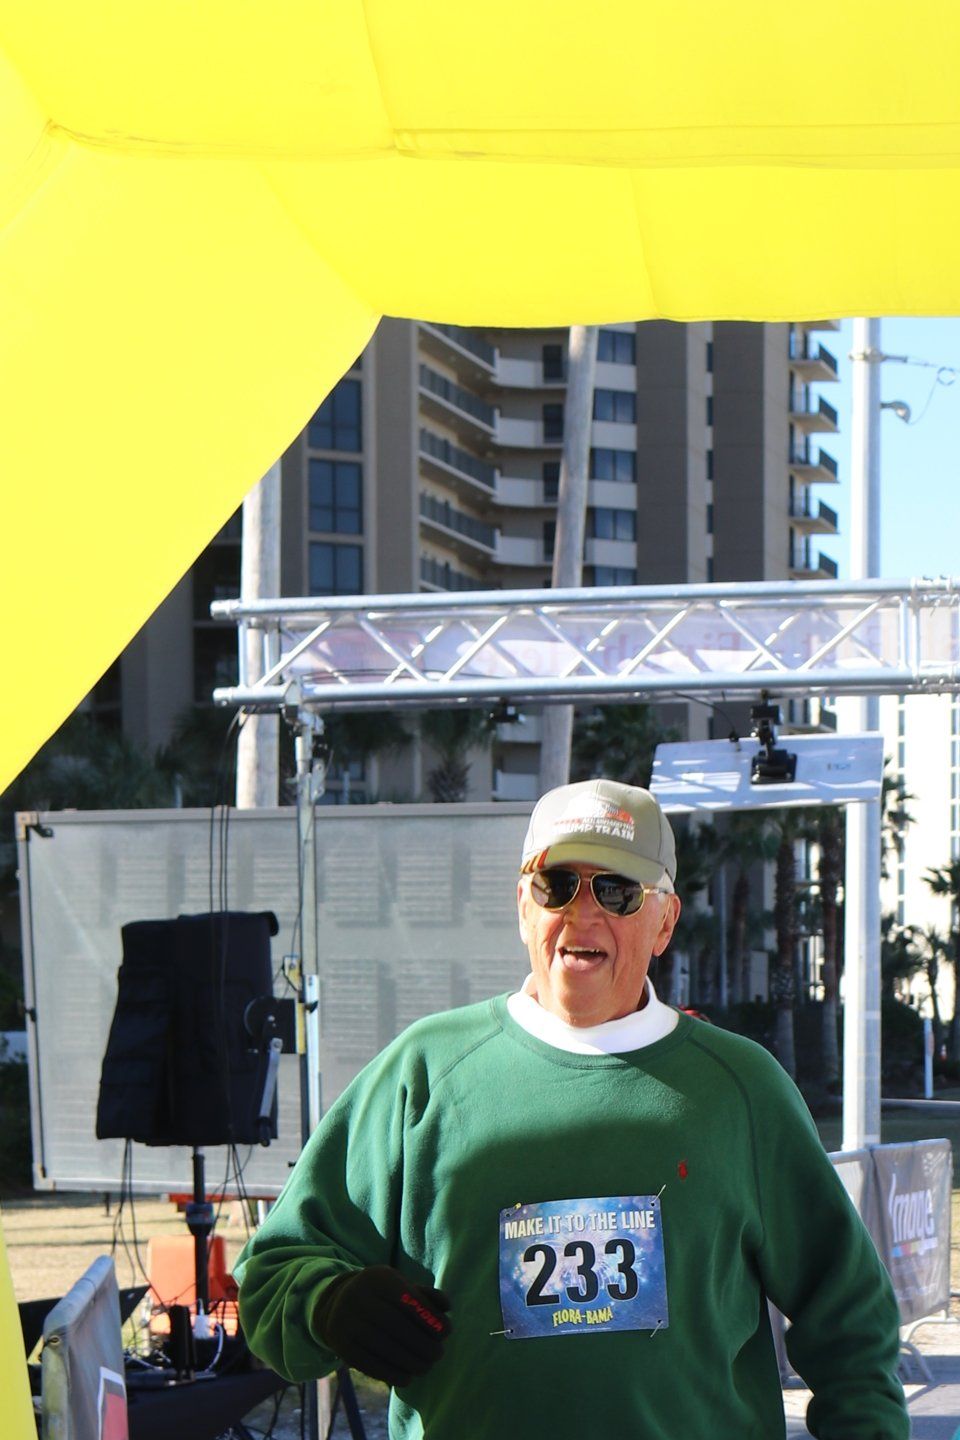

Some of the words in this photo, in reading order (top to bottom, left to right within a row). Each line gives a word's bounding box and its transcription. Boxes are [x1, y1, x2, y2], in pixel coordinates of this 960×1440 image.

[595, 824, 635, 842] TRAIN
[504, 1216, 545, 1240] MAKE
[548, 1215, 562, 1234] IT
[566, 1212, 586, 1232] TO
[588, 1211, 618, 1231] THE
[621, 1209, 656, 1230] LINE
[523, 1238, 640, 1307] 233
[552, 1306, 614, 1328] FLORA-BAMA
